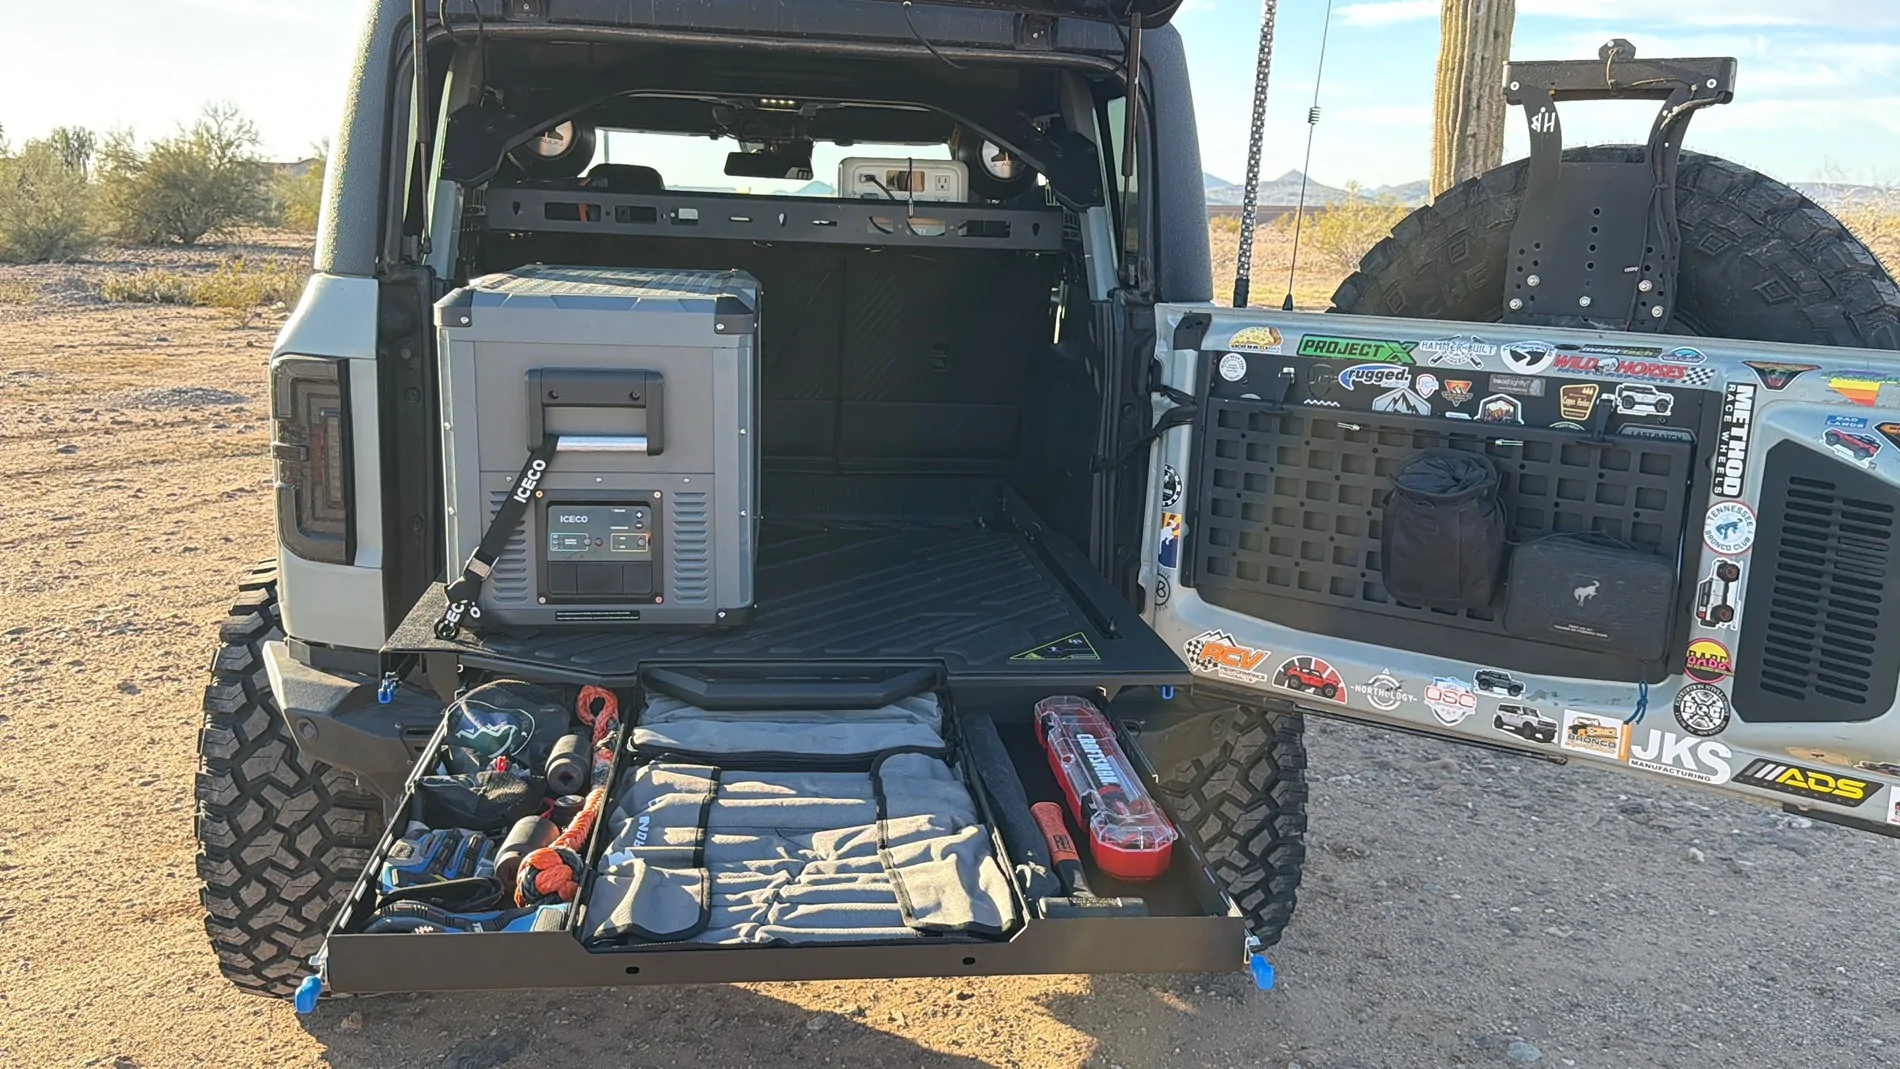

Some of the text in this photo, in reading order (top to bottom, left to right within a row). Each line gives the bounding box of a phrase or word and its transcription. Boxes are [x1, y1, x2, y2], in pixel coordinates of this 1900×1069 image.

[1302, 339, 1385, 357] PROJECT
[1348, 368, 1409, 382] rugged.
[1553, 354, 1688, 379] WILD HORSES
[1714, 384, 1736, 494] RACE WHEELS
[1723, 385, 1754, 496] METHOD
[513, 459, 547, 504] ICECO
[560, 515, 589, 523] ICECO
[1707, 504, 1754, 528] TENNESSEE
[1705, 535, 1751, 551] BRONCO CLUB
[1200, 642, 1265, 671] RCV
[1425, 686, 1476, 708] OSC
[1567, 733, 1617, 748] BRONCO
[1076, 733, 1119, 785] CRAFTSMAN
[1630, 728, 1732, 785] JKS
[1630, 759, 1712, 782] MANUFACTURING
[1775, 768, 1867, 800] ADS
